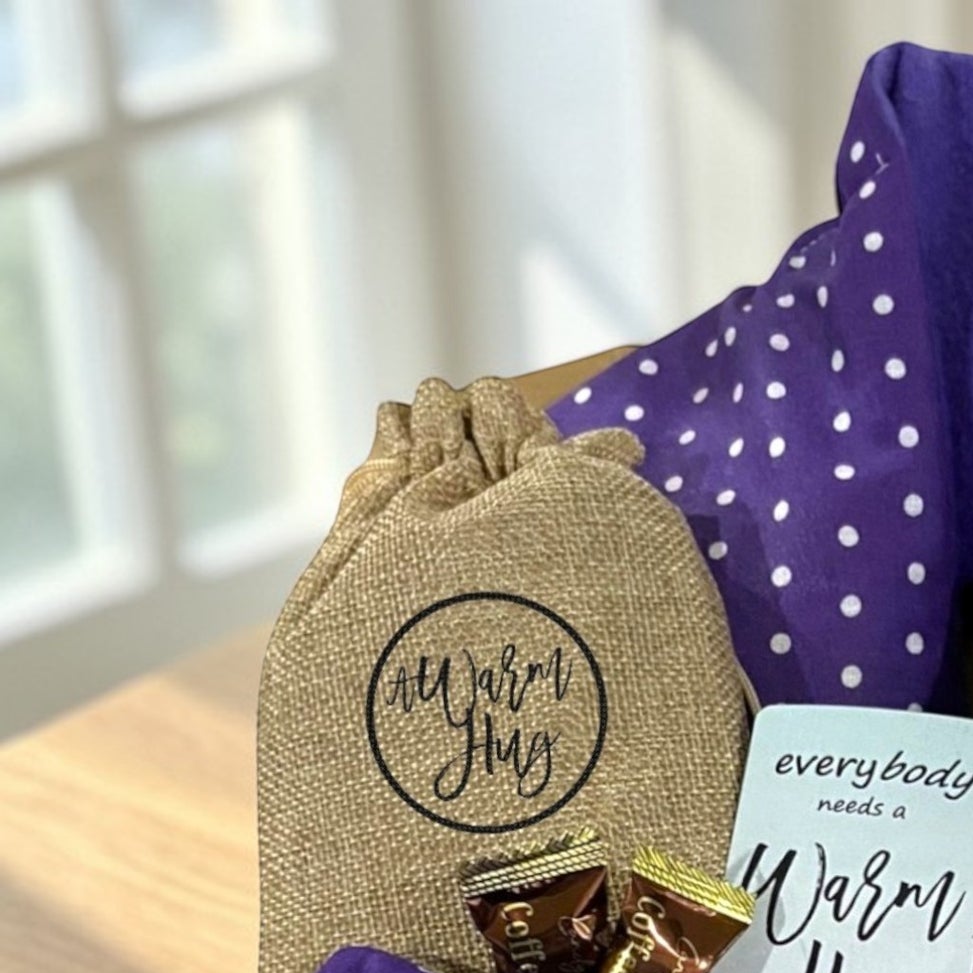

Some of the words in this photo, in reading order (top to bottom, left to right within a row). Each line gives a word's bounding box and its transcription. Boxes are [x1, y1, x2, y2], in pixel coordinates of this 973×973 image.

[417, 644, 573, 729] Warm
[433, 707, 562, 801] Hug
[817, 798, 884, 818] needs
[892, 804, 907, 820] a
[743, 843, 967, 946] Warm
